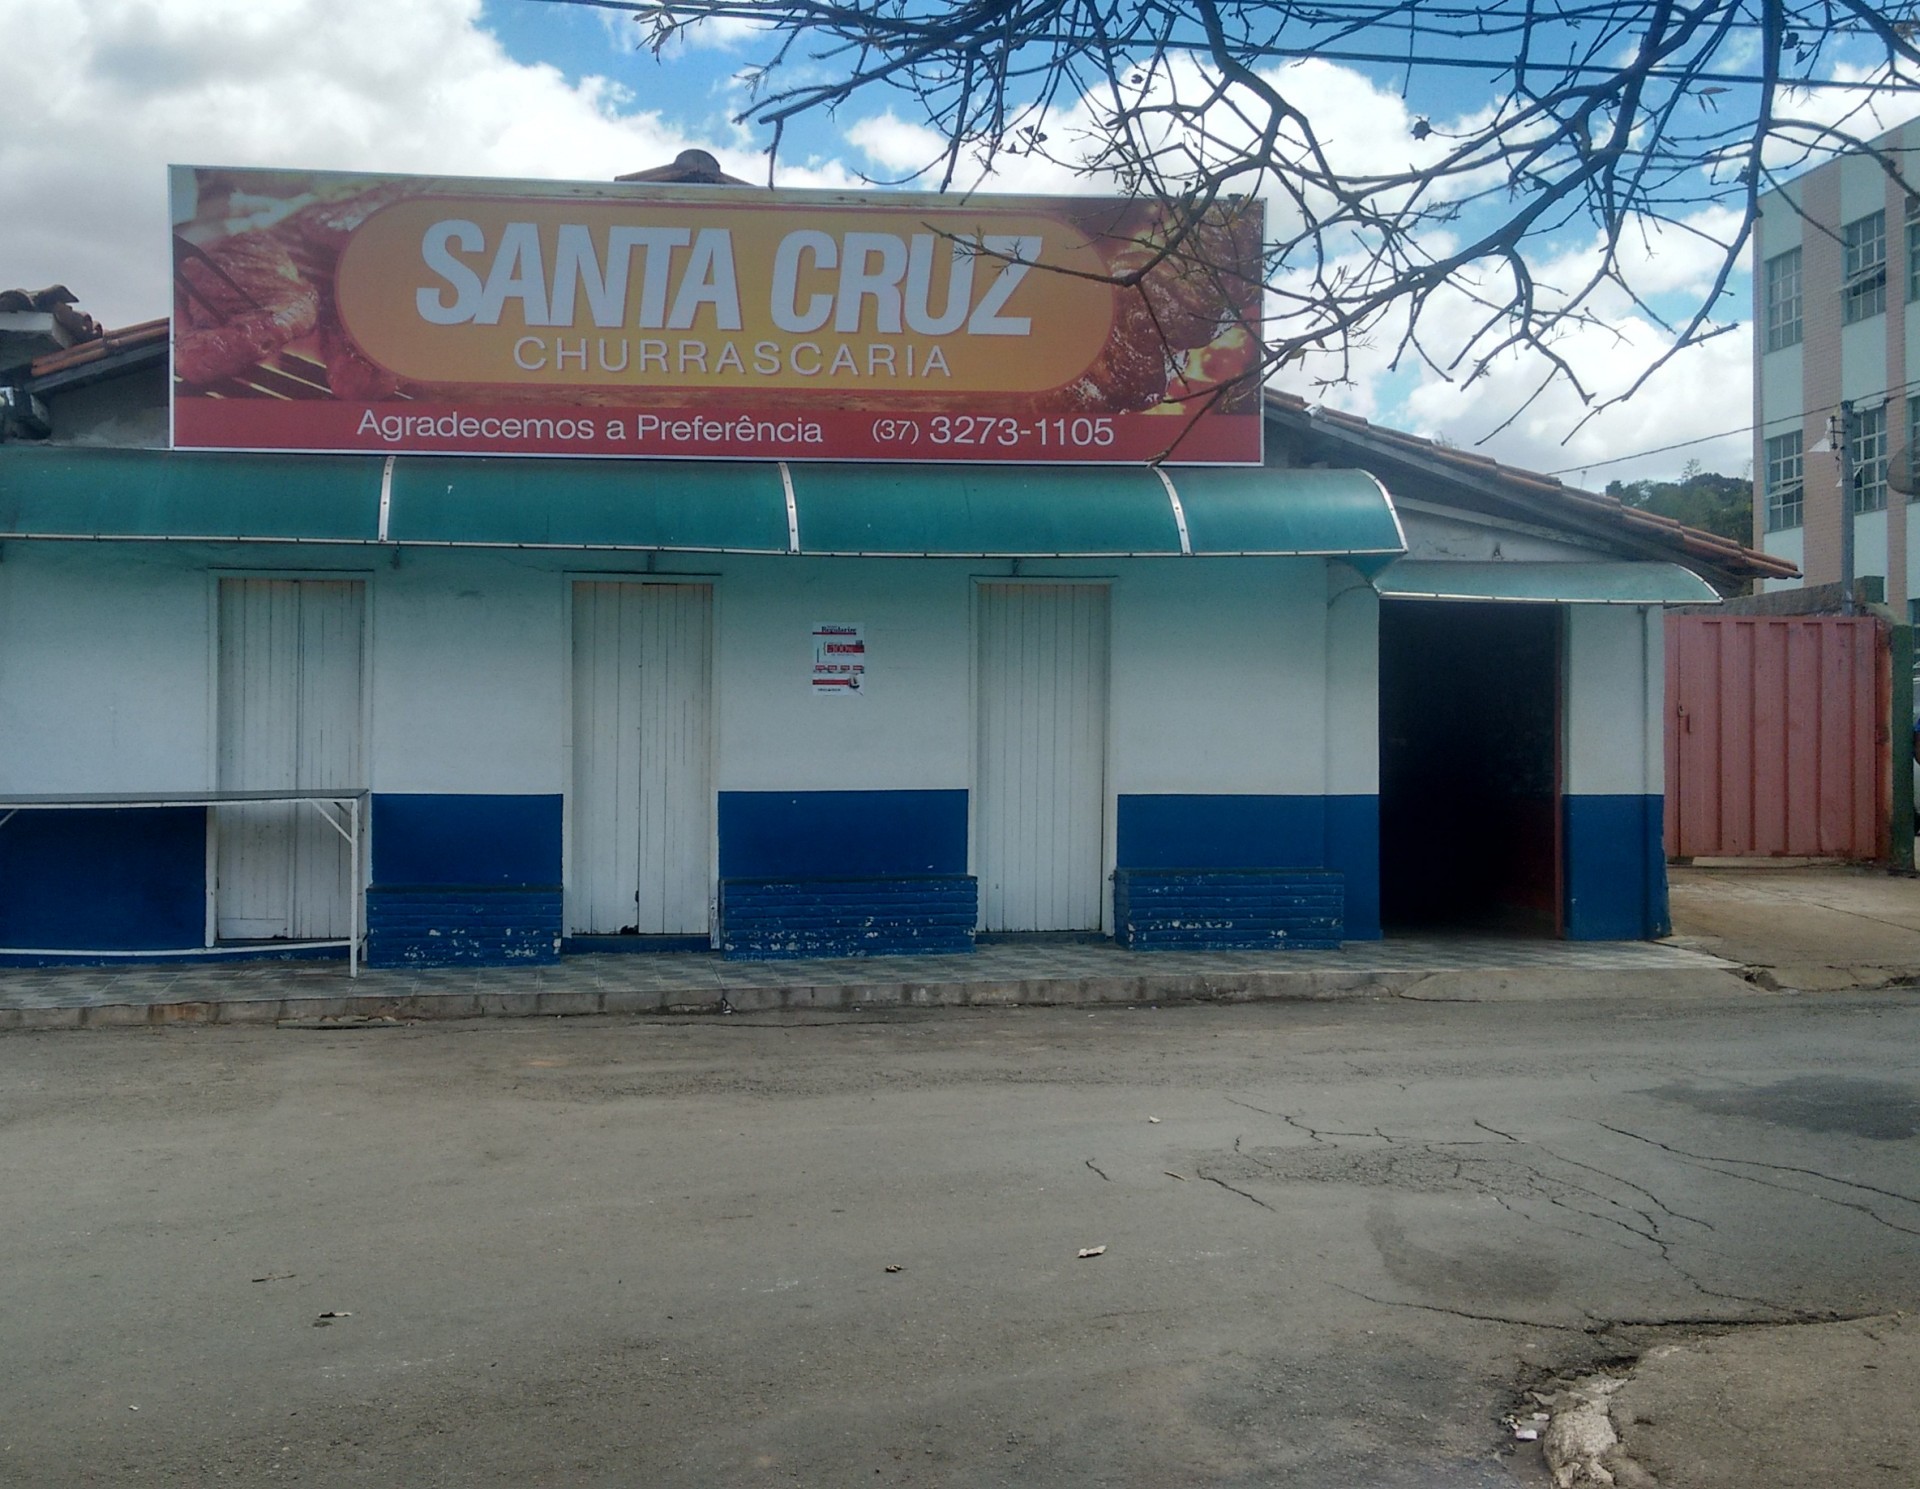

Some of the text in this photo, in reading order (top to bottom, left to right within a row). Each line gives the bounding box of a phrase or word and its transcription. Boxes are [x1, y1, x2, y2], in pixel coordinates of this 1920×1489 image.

[416, 218, 1043, 336] SANTA CRUZ
[512, 335, 953, 378] CHURRASCARIA
[356, 408, 1115, 446] Agradecemos a Preferência (37) 3273-1105
